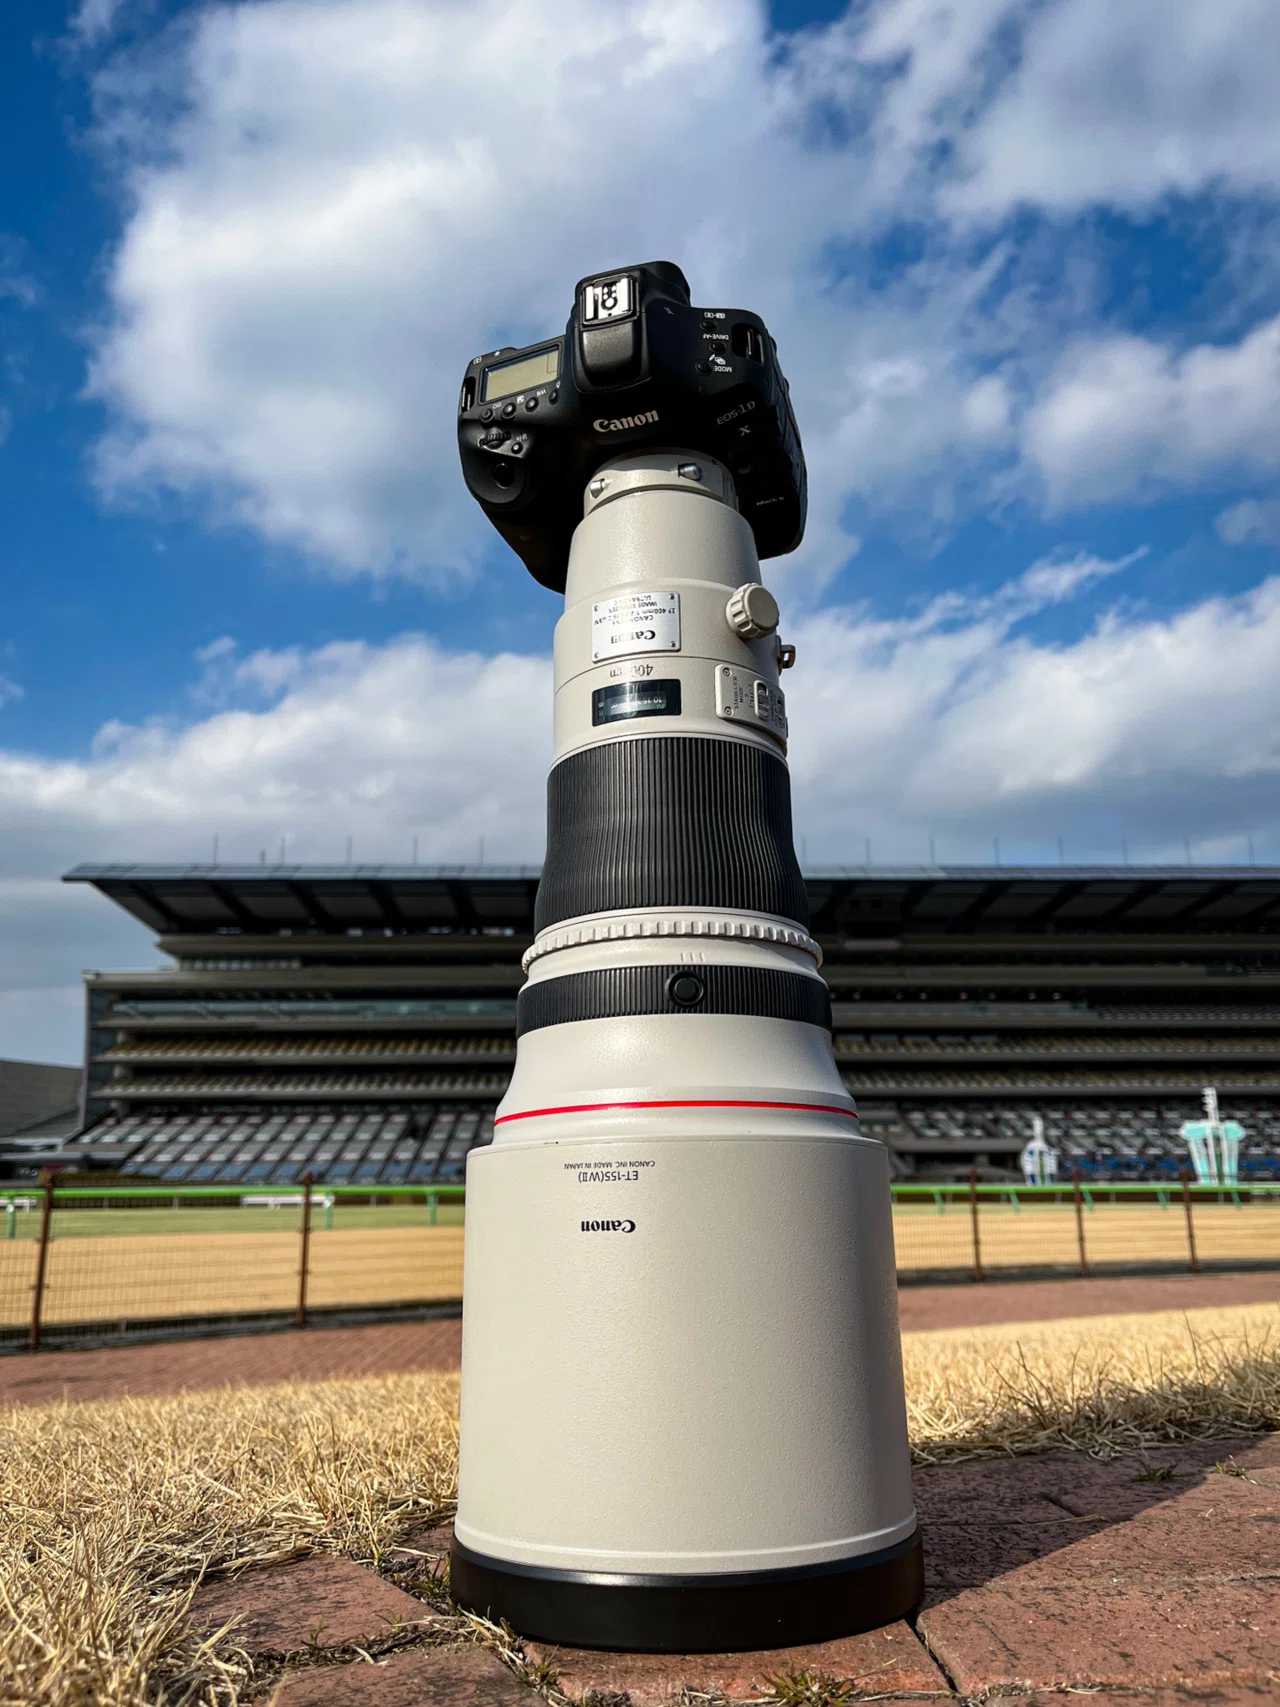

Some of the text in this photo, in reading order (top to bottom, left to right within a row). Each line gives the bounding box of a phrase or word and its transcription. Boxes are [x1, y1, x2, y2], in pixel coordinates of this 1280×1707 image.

[593, 409, 659, 433] Canon
[738, 424, 752, 436] X
[610, 629, 656, 644] Can
[609, 663, 654, 678] 400m
[564, 1162, 583, 1170] JAPAN
[629, 1160, 655, 1168] CANON
[581, 1219, 636, 1234] Canon
